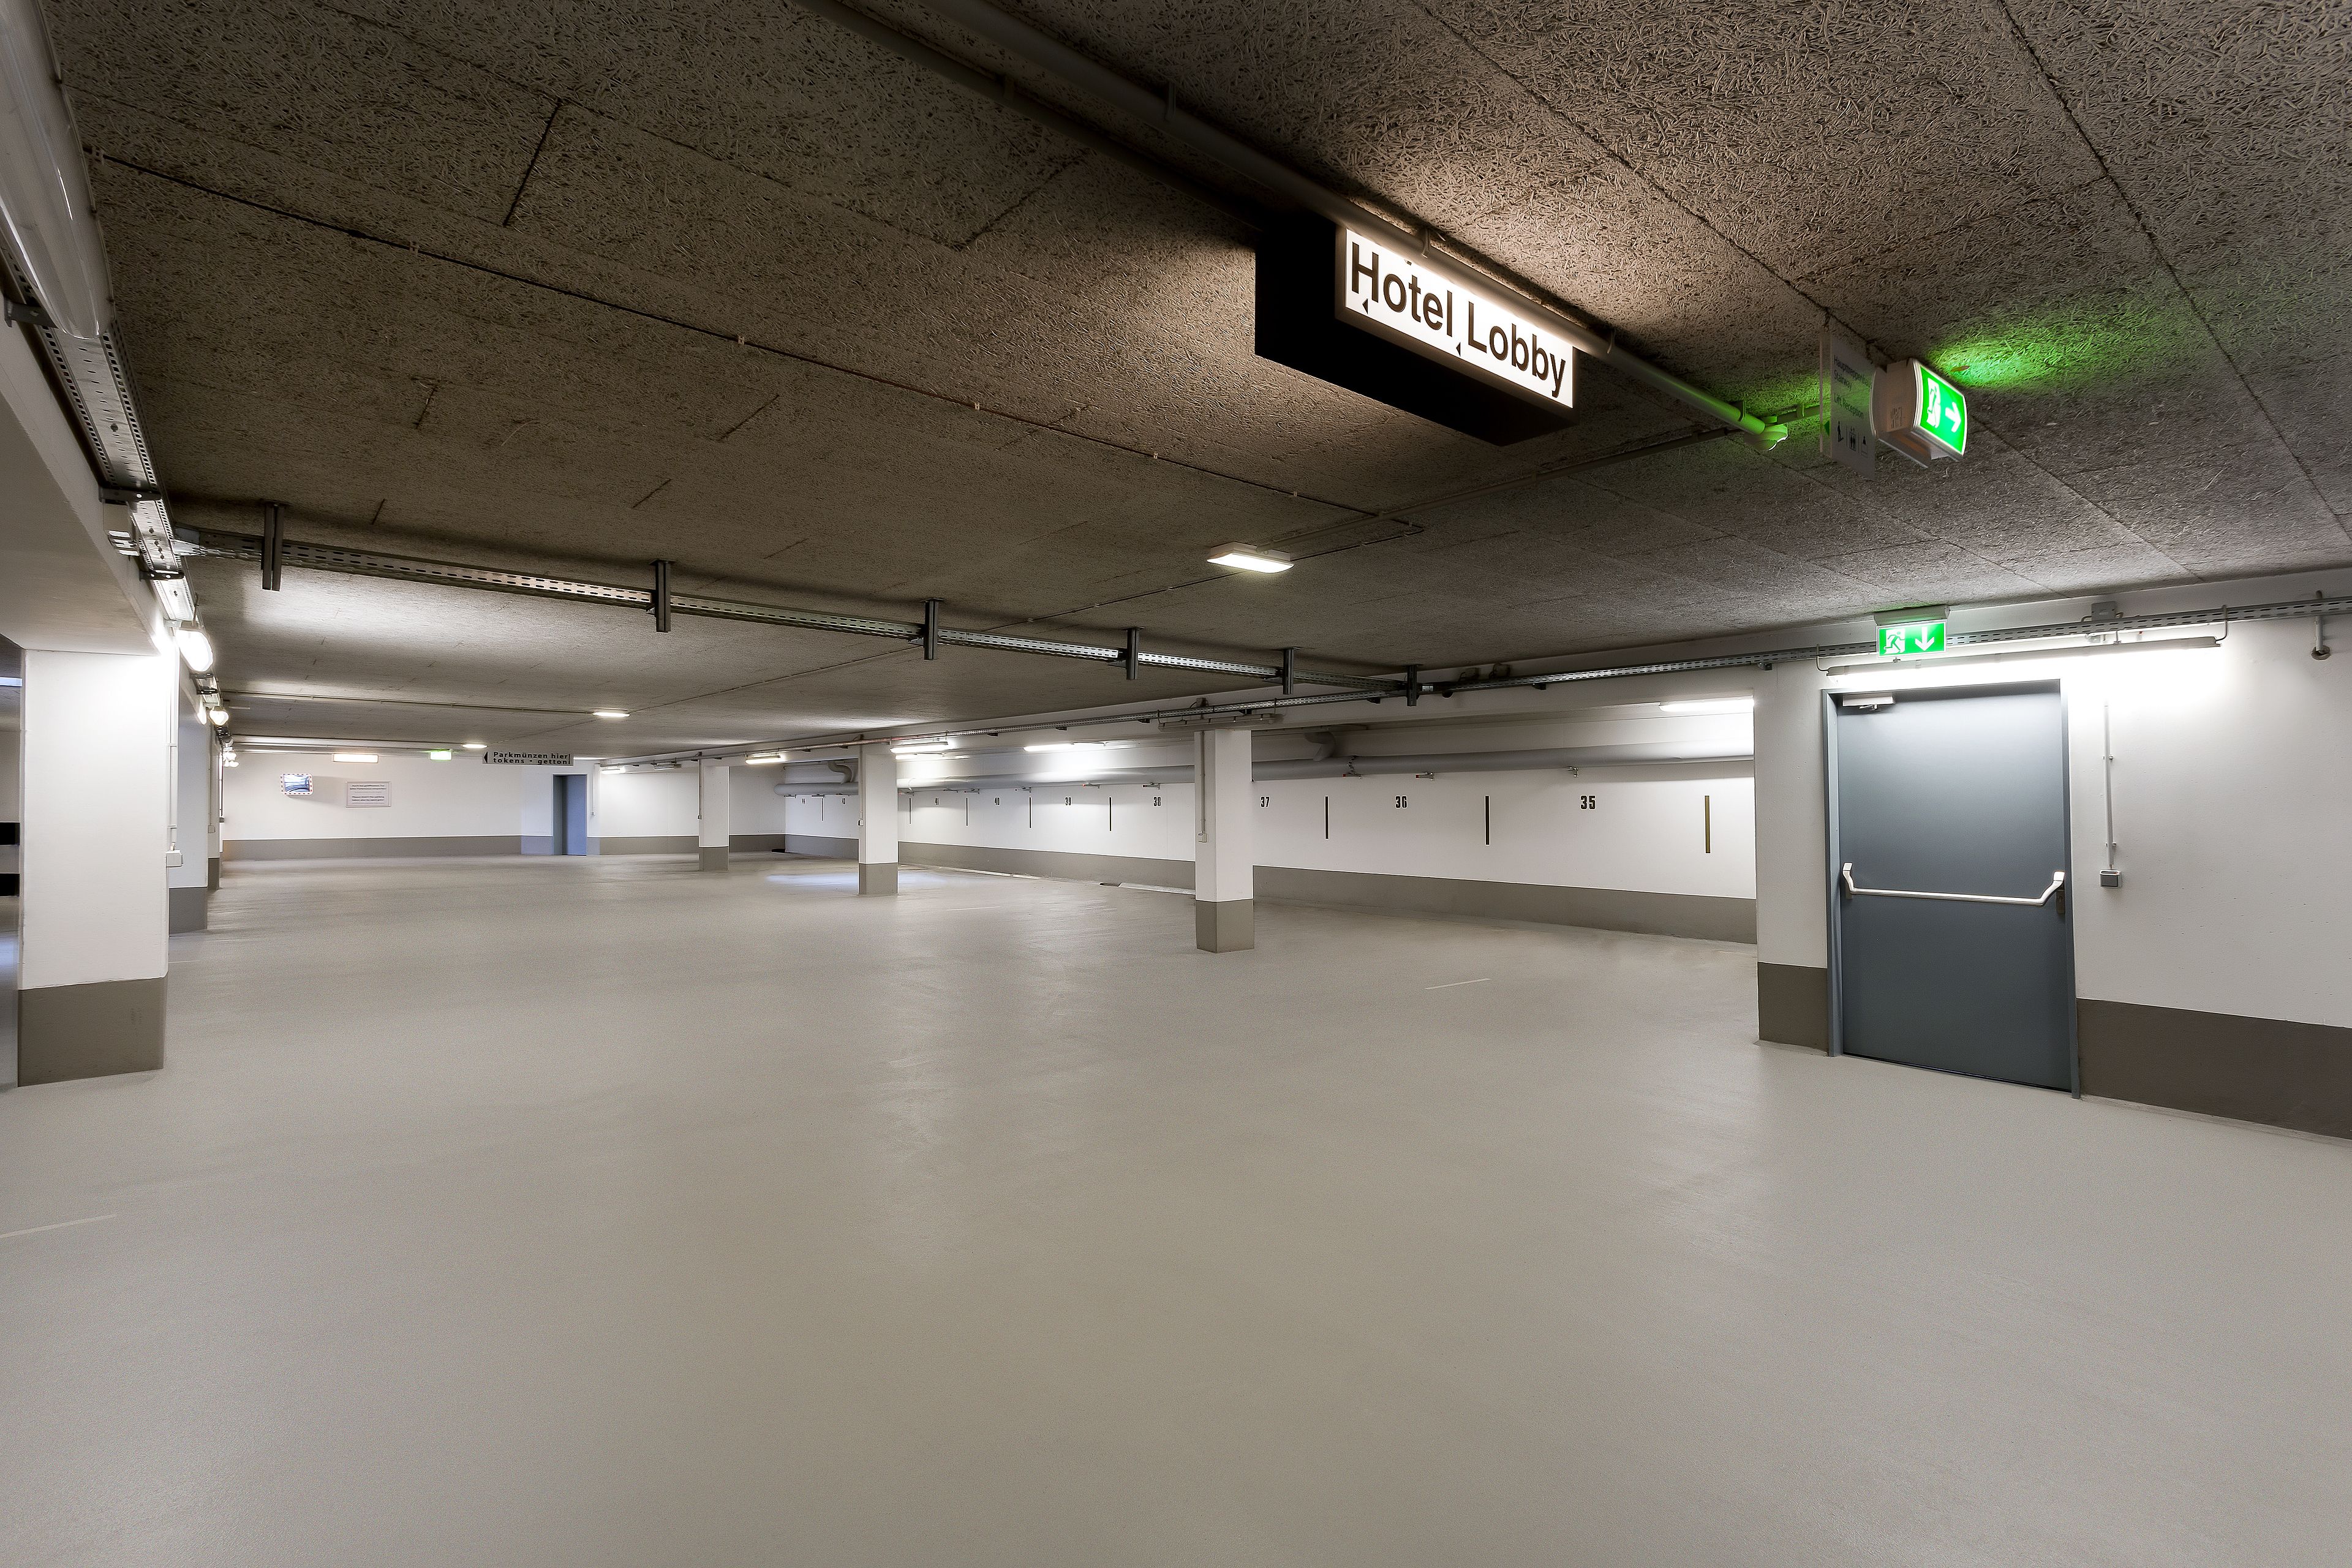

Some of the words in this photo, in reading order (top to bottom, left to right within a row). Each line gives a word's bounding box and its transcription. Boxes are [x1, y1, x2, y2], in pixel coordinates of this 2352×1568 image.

[1352, 242, 1453, 338] Hotel
[1468, 301, 1566, 399] Lobby
[1834, 369, 1853, 392] Stairway
[1842, 397, 1864, 420] Reception
[1153, 796, 1161, 807] 38
[1261, 796, 1270, 808] 37
[1395, 796, 1408, 809] 36
[1580, 795, 1596, 810] 35
